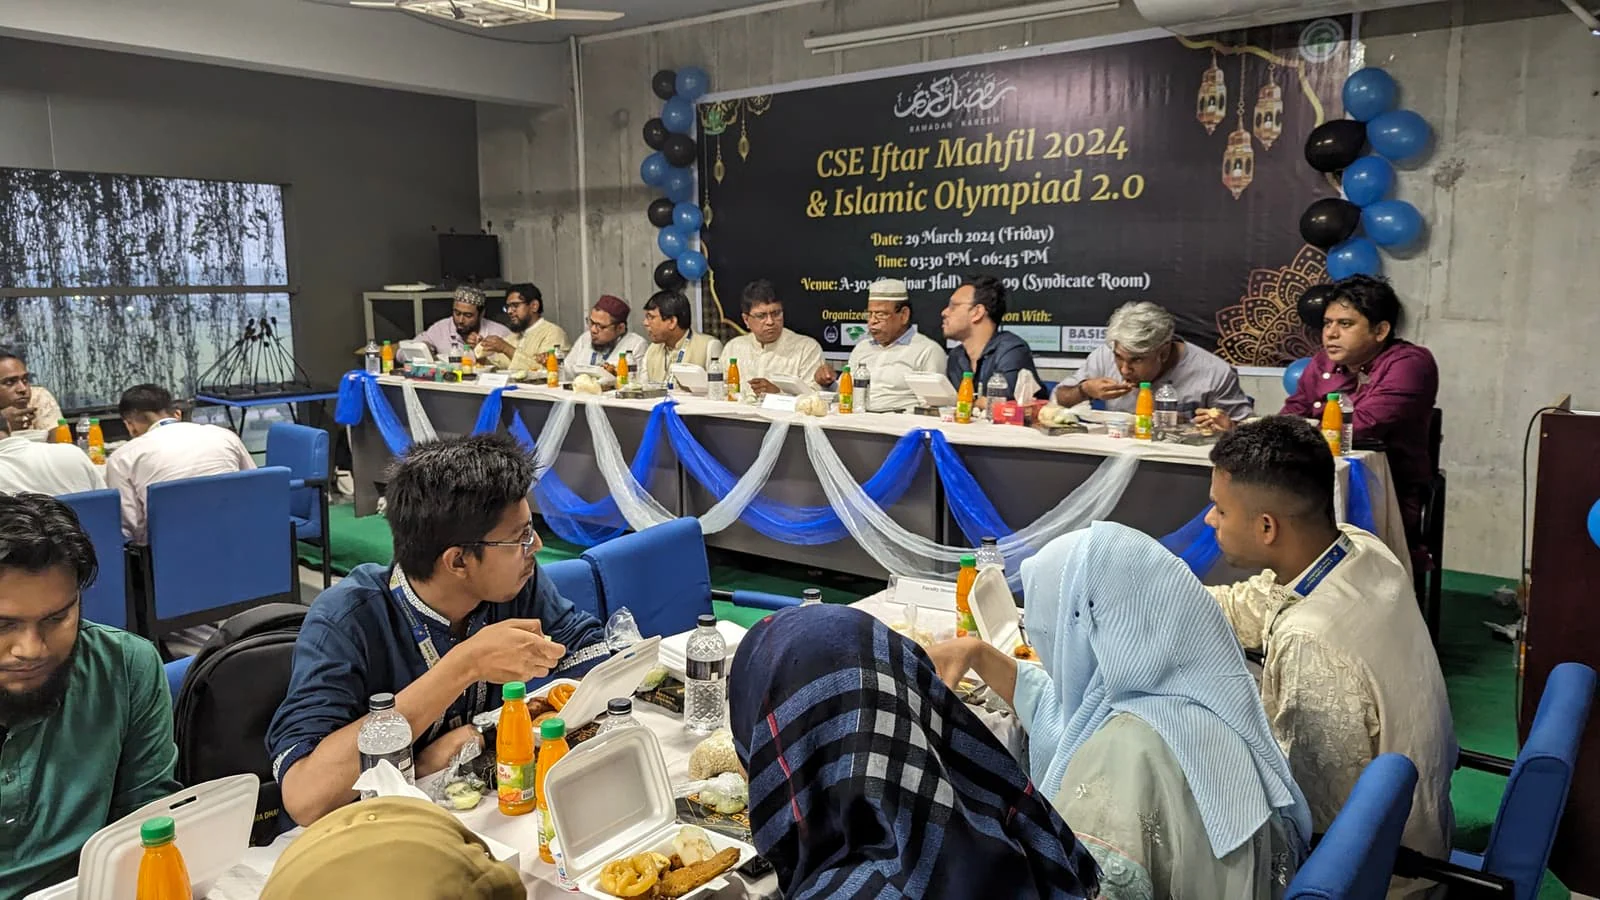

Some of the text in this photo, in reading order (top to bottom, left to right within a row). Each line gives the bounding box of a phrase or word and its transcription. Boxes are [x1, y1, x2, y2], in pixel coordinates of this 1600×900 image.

[909, 116, 1000, 133] RAMADAN KAREEM
[816, 125, 1129, 182] CSE Iftar Mahfil 2024
[806, 168, 1145, 218] & Islamic Olympiad 2.0
[870, 224, 1055, 248] Date: 29 March 2024 (Friday)
[874, 254, 908, 268] Time:
[909, 256, 944, 270] 03:30
[944, 248, 973, 266] PM
[981, 250, 1019, 268] 06:45
[1020, 246, 1051, 265] PM
[800, 277, 838, 291] Venue:
[928, 272, 962, 292] Hall)
[1022, 273, 1095, 292] (Syndicate
[1097, 272, 1150, 290] Room)
[1022, 310, 1052, 322] With:
